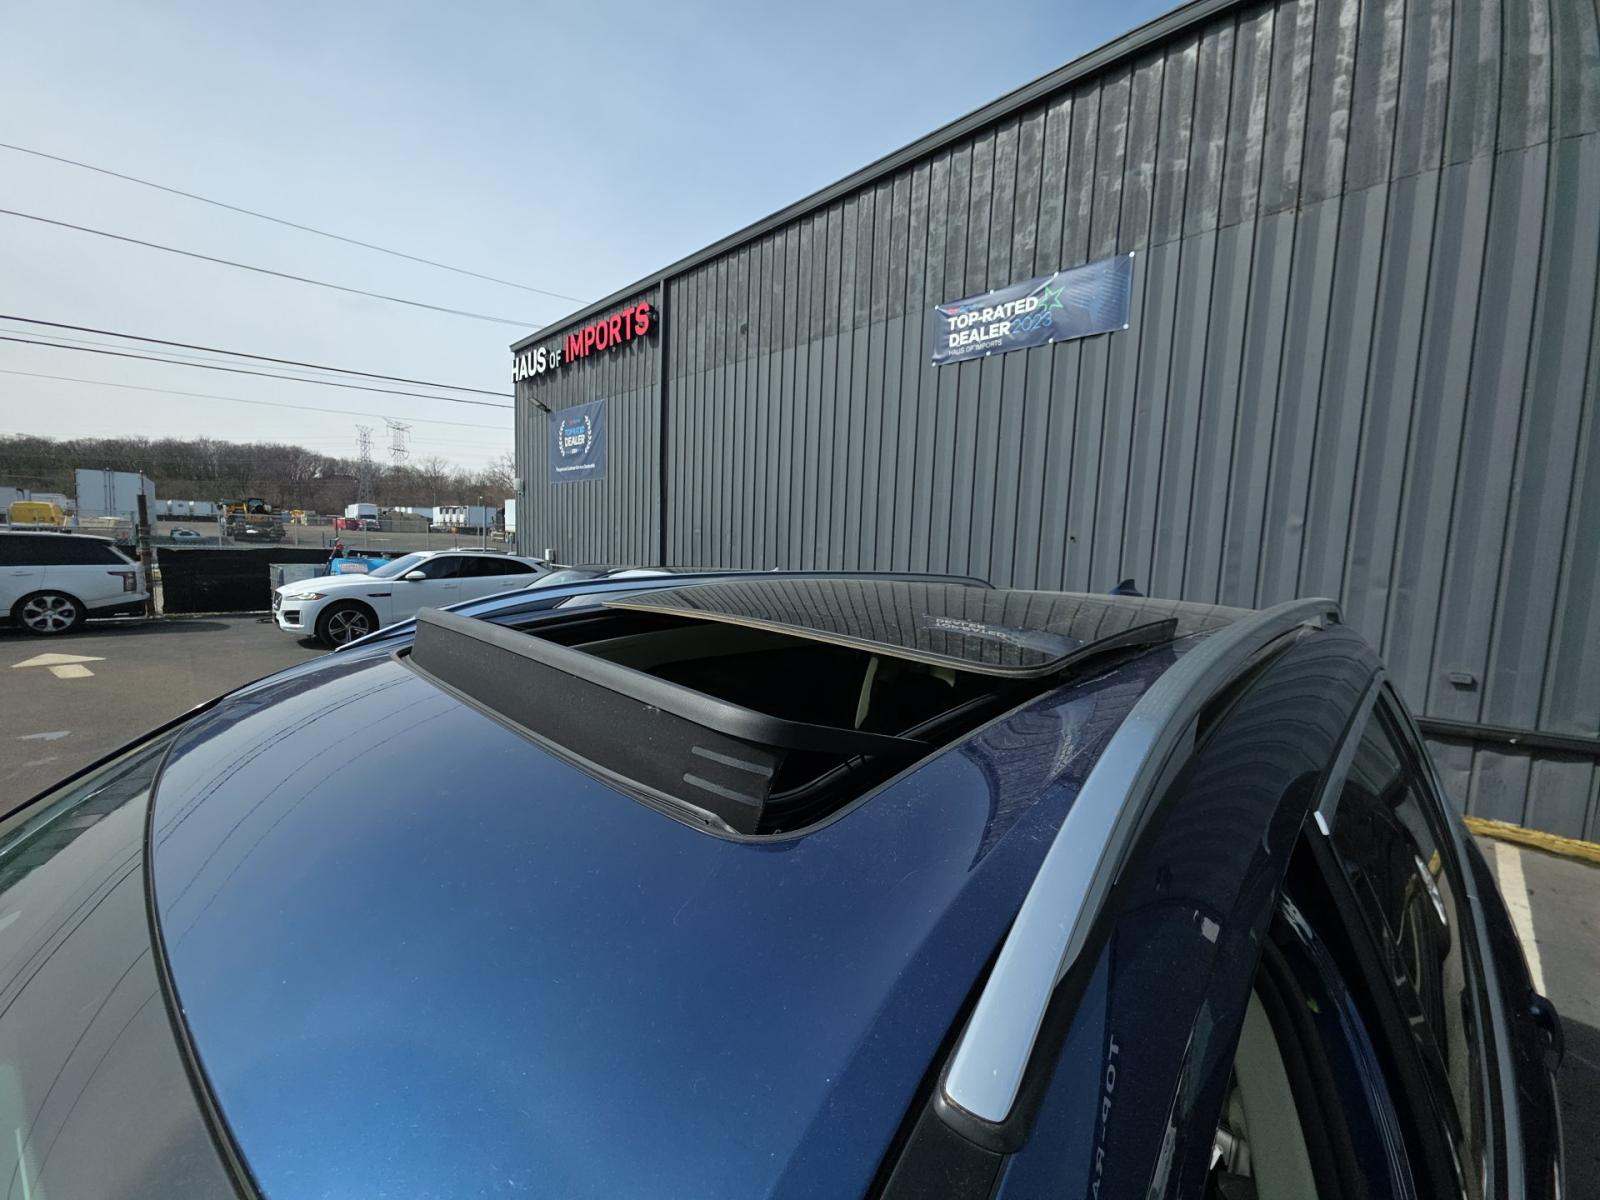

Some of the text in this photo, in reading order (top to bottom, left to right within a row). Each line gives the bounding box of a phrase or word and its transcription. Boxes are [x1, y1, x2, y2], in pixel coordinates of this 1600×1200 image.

[949, 297, 1038, 330] TOP-RATED
[511, 301, 650, 383] HAUS OF IMPORTS
[948, 322, 1011, 347] DEALER
[975, 339, 1002, 351] IMPORTS
